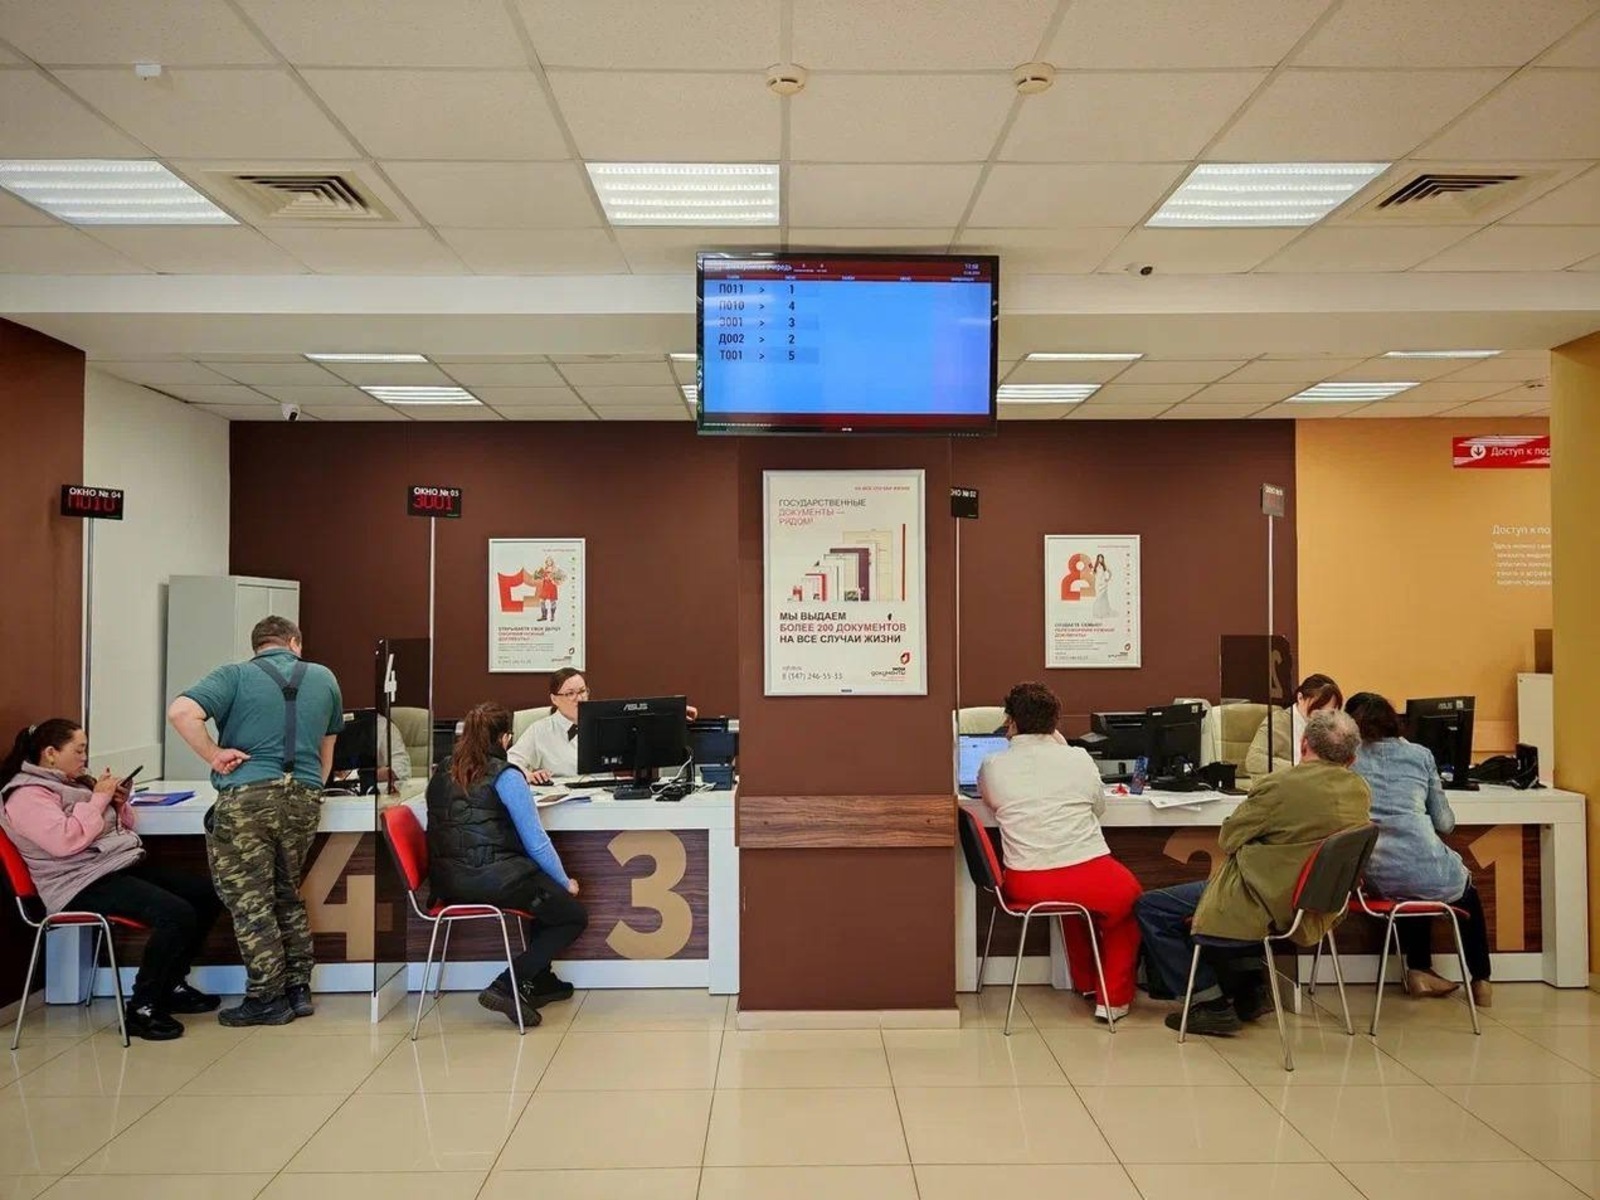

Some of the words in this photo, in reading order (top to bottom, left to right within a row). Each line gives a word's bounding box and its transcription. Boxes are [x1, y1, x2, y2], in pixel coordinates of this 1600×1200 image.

[719, 284, 744, 294] П011
[789, 284, 794, 294] 1
[719, 300, 745, 311] П010
[788, 301, 795, 311] 4
[788, 317, 795, 327] 3
[719, 333, 745, 345] Д002
[788, 334, 795, 344] 2
[720, 350, 743, 360] Т001
[788, 351, 795, 361] 5
[1491, 447, 1524, 458] Доступ
[1527, 448, 1533, 456] к
[69, 487, 97, 497] ОКНО
[98, 490, 109, 498] №
[111, 491, 121, 499] 04
[413, 487, 438, 496] ОКНО
[779, 499, 867, 507] ГОСУДАРСТВЕННЫЕ
[779, 508, 834, 517] ДОКУМЕНТЫ
[1492, 525, 1528, 536] Доступ
[780, 612, 798, 621] МЫ
[800, 612, 847, 622] ВЫДАЕМ
[780, 623, 814, 632] БОЛЕЕ
[817, 623, 834, 632] 200
[836, 623, 907, 633] ДОКУМЕНТОВ
[780, 635, 794, 643] НА
[797, 635, 817, 643] ВСЕ
[820, 635, 861, 644] СЛУЧАИ
[864, 635, 901, 643] ЖИЗНИ
[623, 703, 648, 711] ASUS
[1468, 825, 1525, 951] 1
[299, 832, 393, 961] 4
[606, 829, 693, 960] 3
